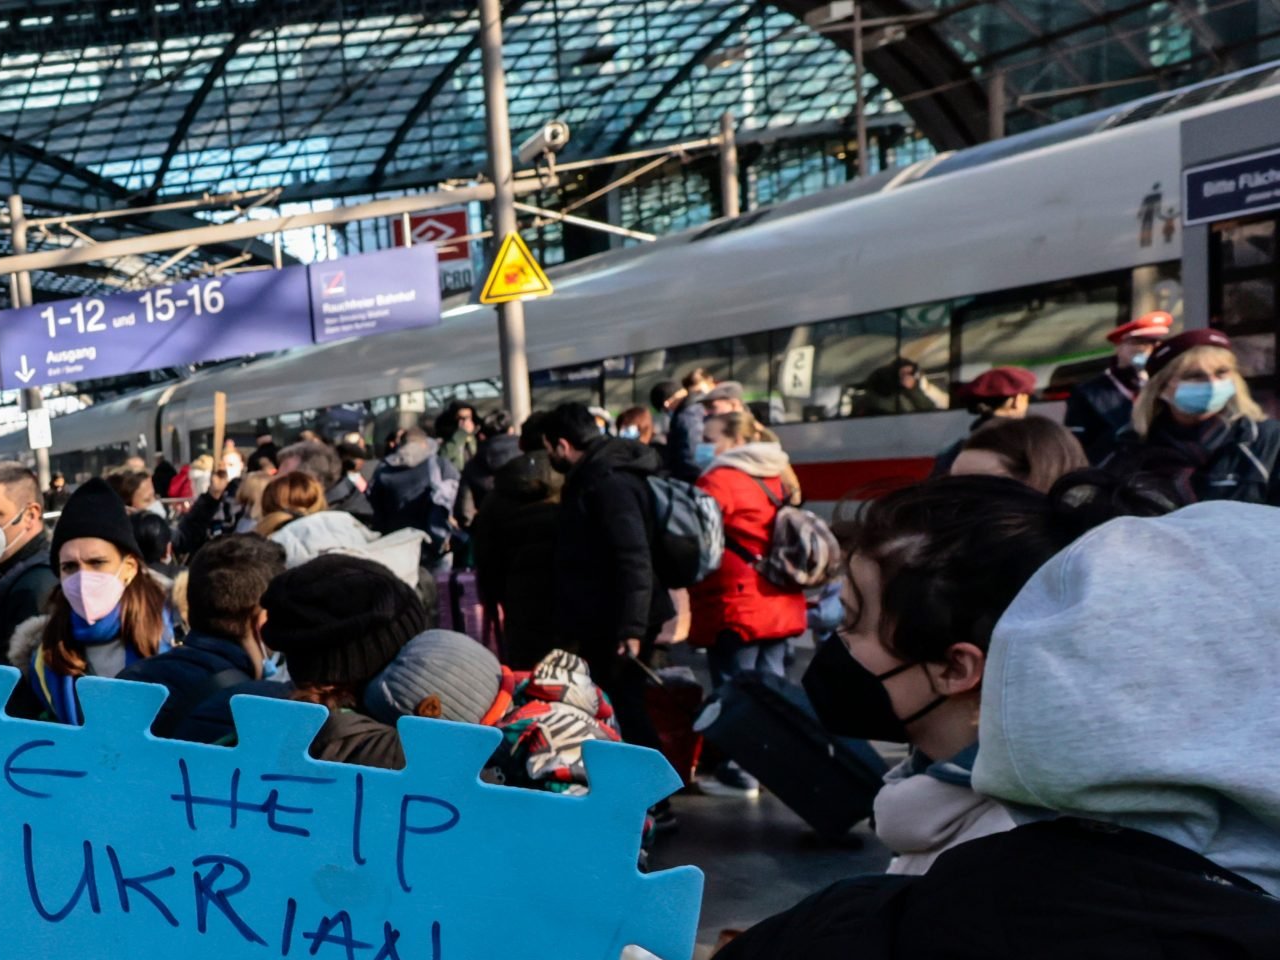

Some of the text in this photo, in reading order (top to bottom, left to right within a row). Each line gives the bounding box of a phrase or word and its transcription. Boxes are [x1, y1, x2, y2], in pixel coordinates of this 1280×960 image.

[41, 299, 107, 338] 1-12
[139, 280, 225, 323] 15-16
[46, 346, 97, 364] Ausgang
